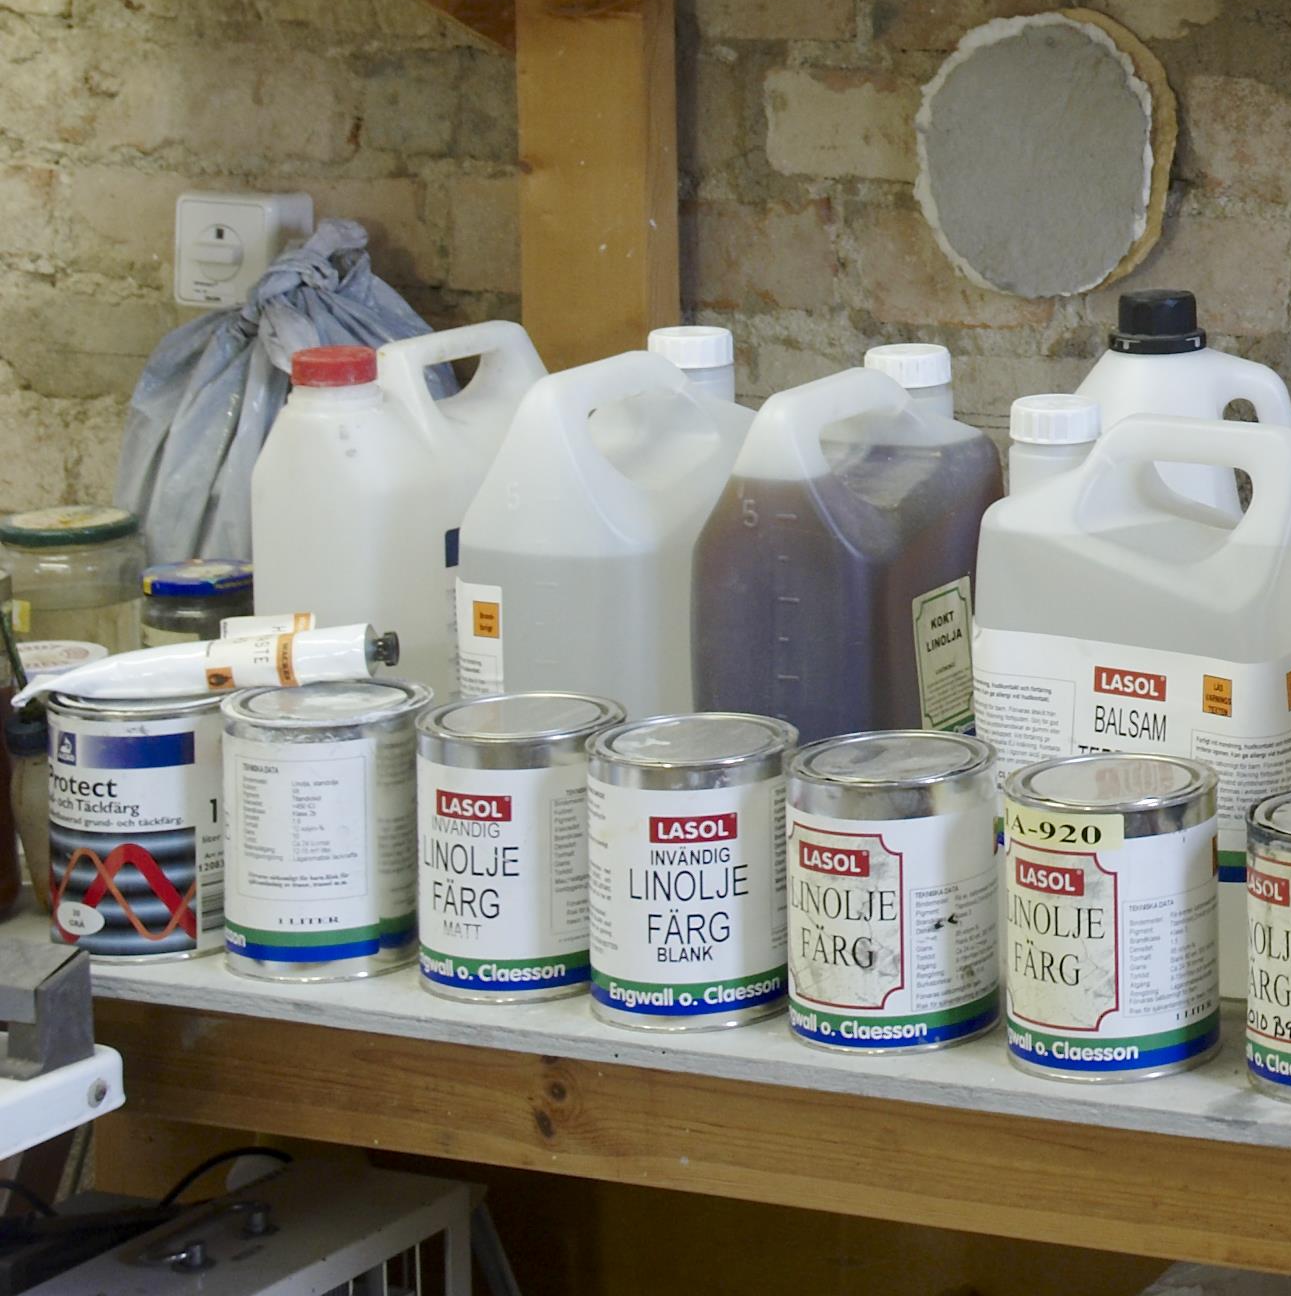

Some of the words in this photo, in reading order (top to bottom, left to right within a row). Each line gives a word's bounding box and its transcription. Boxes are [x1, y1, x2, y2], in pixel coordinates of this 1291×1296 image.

[930, 610, 955, 630] KOKT
[925, 627, 963, 653] LINOLJA
[1101, 670, 1160, 697] LASOL
[1094, 704, 1167, 743] BALSAM
[77, 798, 140, 818] Täckfärg
[209, 798, 218, 824] 1
[440, 797, 503, 819] LASOL
[116, 817, 135, 826] och
[431, 813, 501, 840] INVÄNDIG
[657, 819, 729, 841] LASOL
[422, 840, 521, 878] LINOLJE
[649, 845, 731, 867] INVÄNDIG
[803, 847, 862, 875] LASOL
[628, 863, 749, 902] LINOLJE
[1018, 867, 1076, 893] LASOL
[1248, 877, 1284, 902] ASOL
[431, 878, 501, 920] FÄRG
[788, 874, 897, 923] LINOLJE
[646, 908, 731, 946] FÄRG
[1006, 889, 1105, 941] LINOLJE
[442, 920, 483, 942] MATT
[656, 944, 714, 963] BLANK
[800, 923, 874, 971] FÄRG
[457, 963, 474, 981] o.
[477, 961, 566, 983] Claesson
[1013, 940, 1081, 988] FÄRG
[608, 980, 673, 1007] Engwall
[678, 991, 699, 1007] o.
[703, 976, 781, 1005] Claesson
[1248, 957, 1291, 1009] ÄRG
[820, 1020, 836, 1037] o.
[840, 1019, 928, 1040] Claesson
[1035, 1042, 1049, 1057] o.
[1052, 1040, 1140, 1064] Claesson
